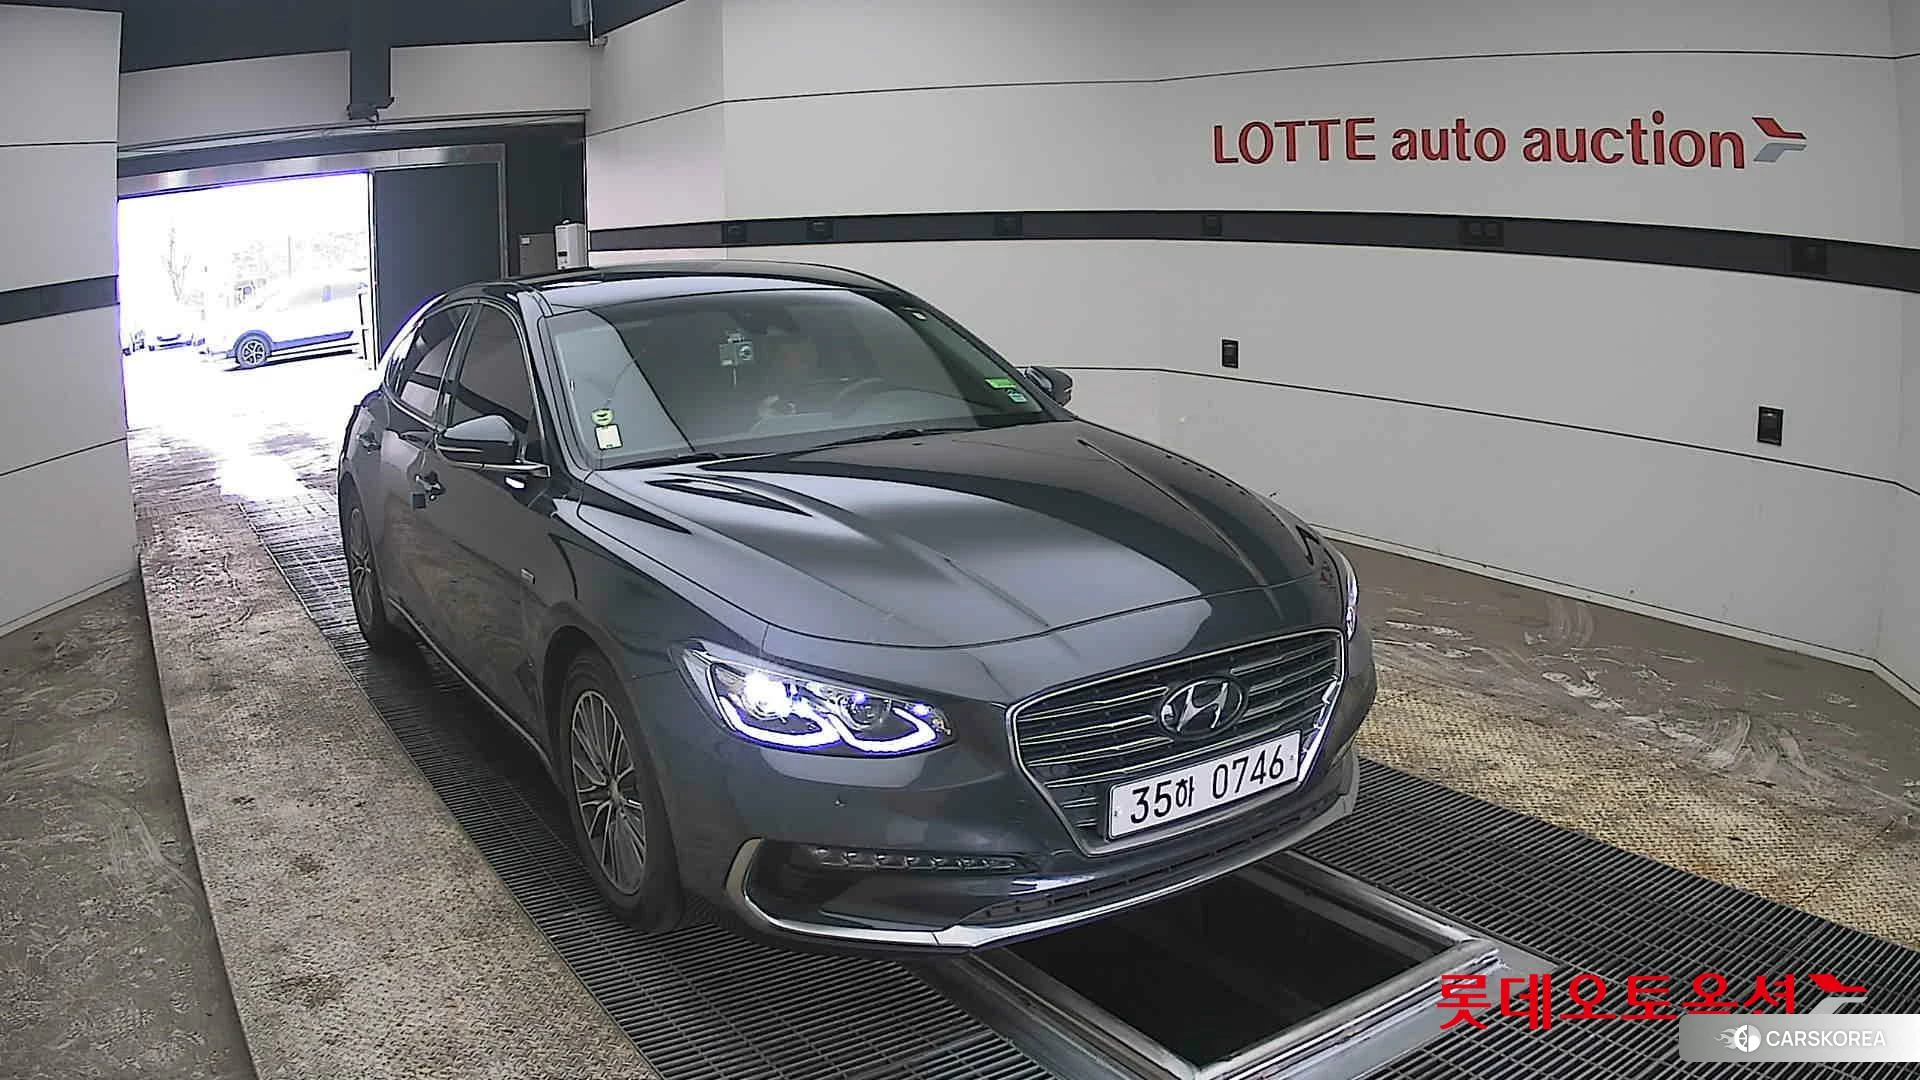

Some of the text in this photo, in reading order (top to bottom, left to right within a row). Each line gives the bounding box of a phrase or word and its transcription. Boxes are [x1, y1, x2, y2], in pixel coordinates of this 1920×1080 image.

[1213, 110, 1746, 169] LOTTE auto auction
[1130, 744, 1284, 824] 35하 0746
